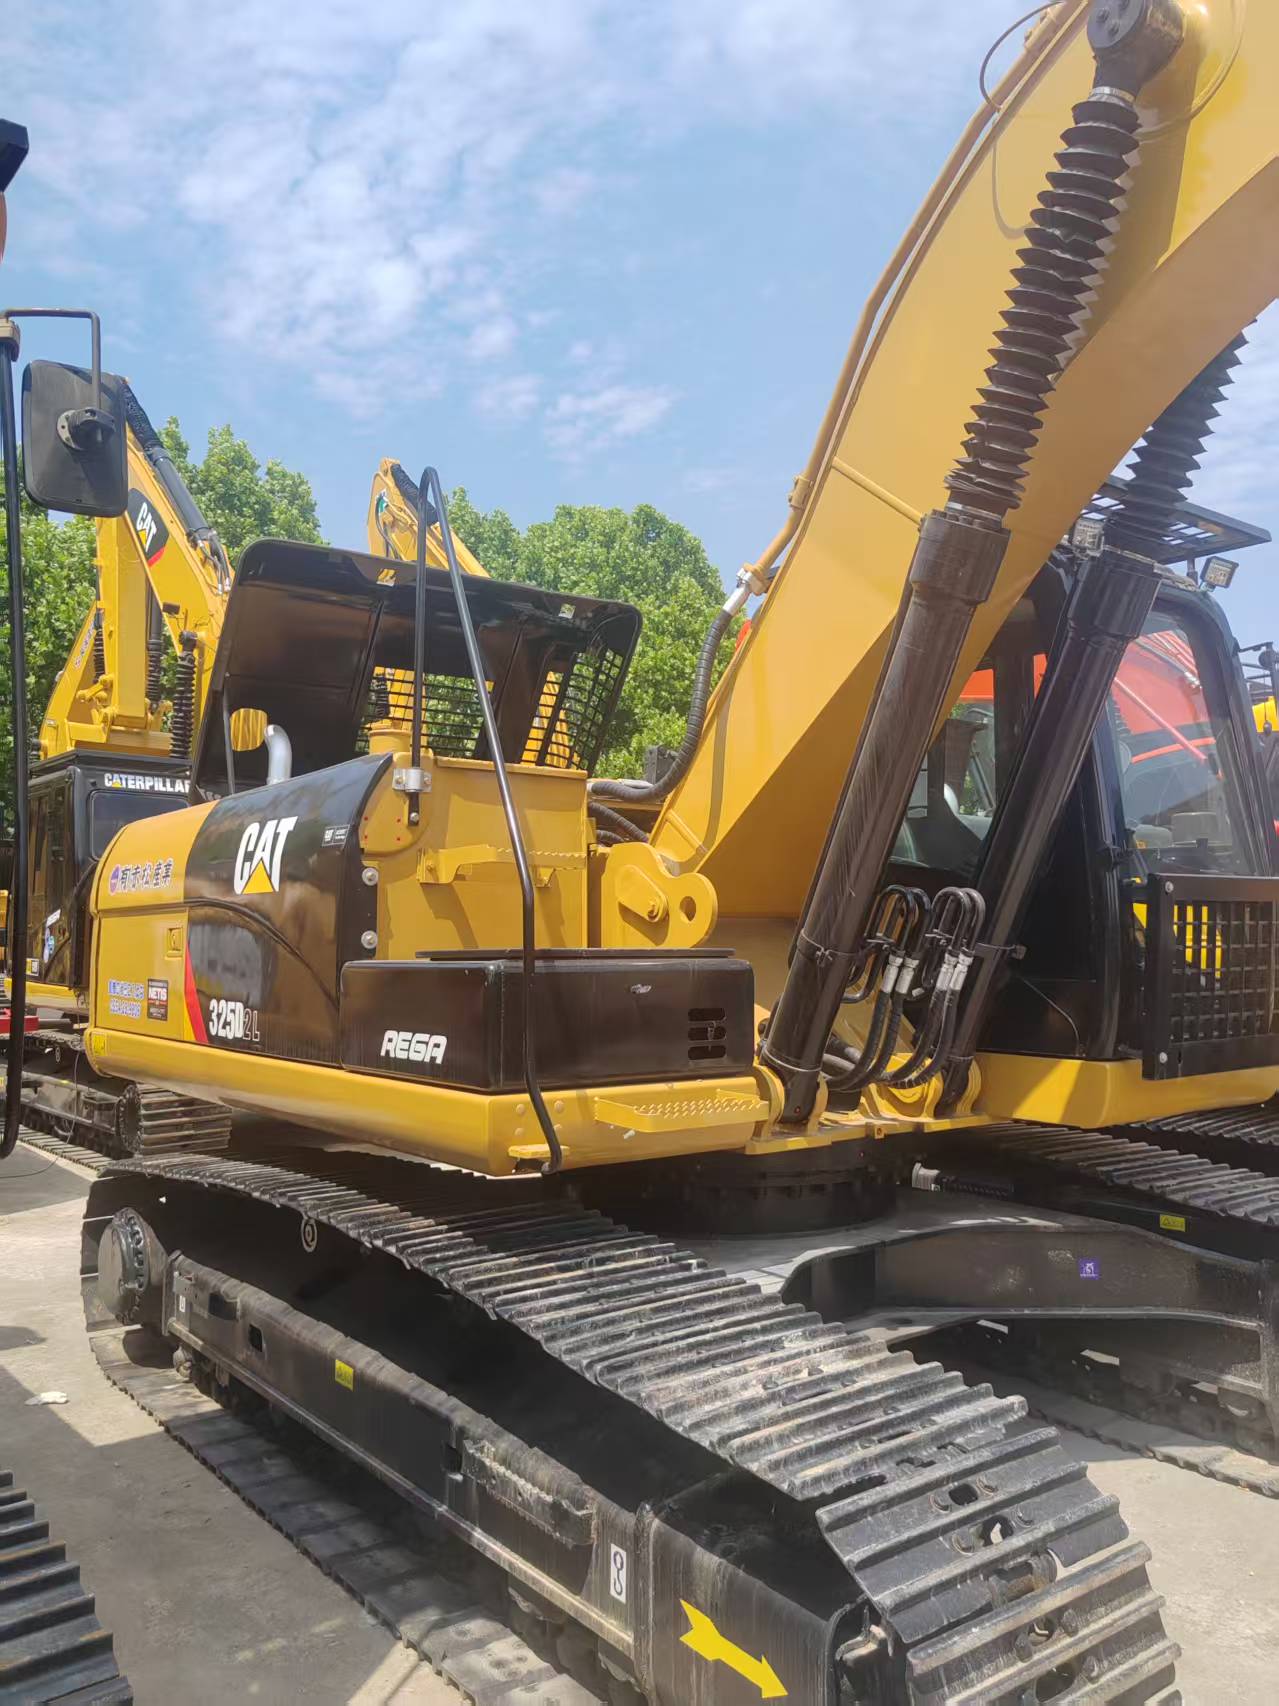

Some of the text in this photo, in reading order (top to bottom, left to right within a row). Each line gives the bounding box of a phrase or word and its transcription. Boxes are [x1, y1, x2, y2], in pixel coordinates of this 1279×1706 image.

[136, 502, 157, 552] CAT
[233, 816, 298, 895] CAT
[380, 1029, 448, 1065] REGA
